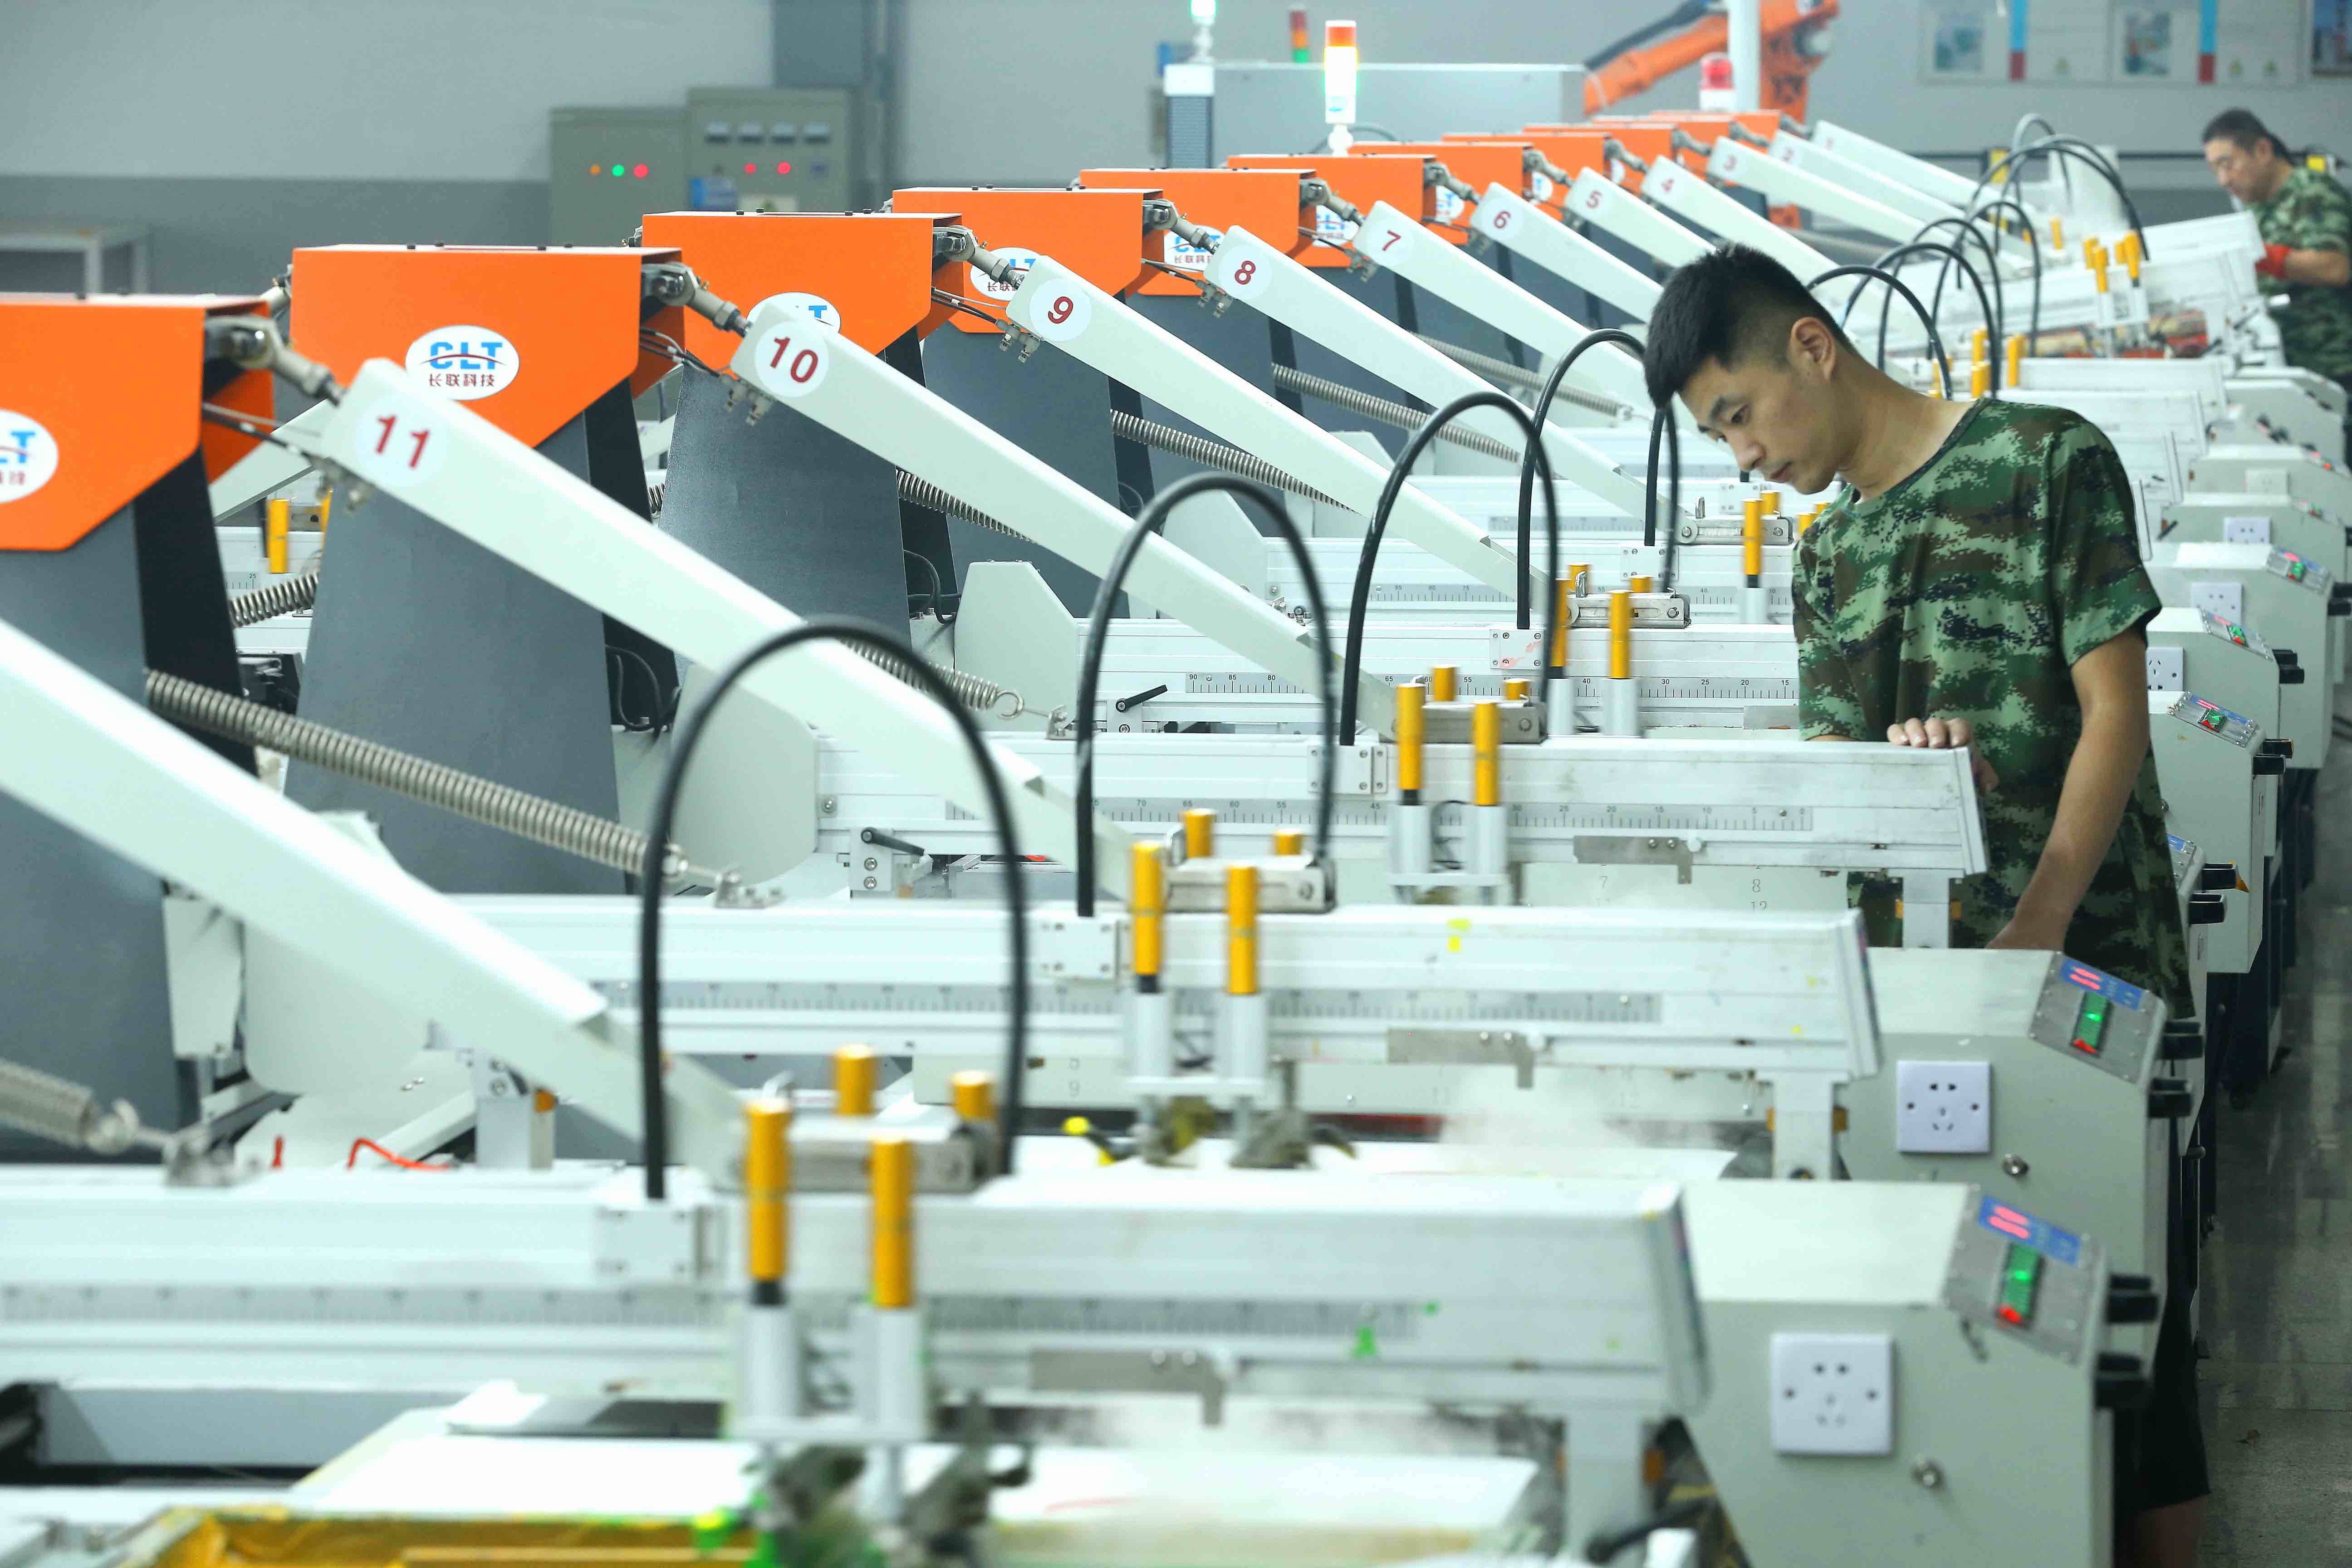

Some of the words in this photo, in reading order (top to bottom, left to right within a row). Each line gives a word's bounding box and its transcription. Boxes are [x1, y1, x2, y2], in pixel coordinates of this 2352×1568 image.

[1586, 189, 1602, 208] 5
[1494, 211, 1511, 229] 6
[1382, 230, 1401, 251] 7
[1235, 260, 1256, 285] 8
[1048, 296, 1073, 324] 9
[430, 342, 503, 369] CLT
[770, 336, 818, 383] 10
[428, 373, 495, 387] 长联科技
[376, 415, 431, 469] 11
[1600, 875, 1609, 890] 7
[1752, 878, 1761, 893] 8
